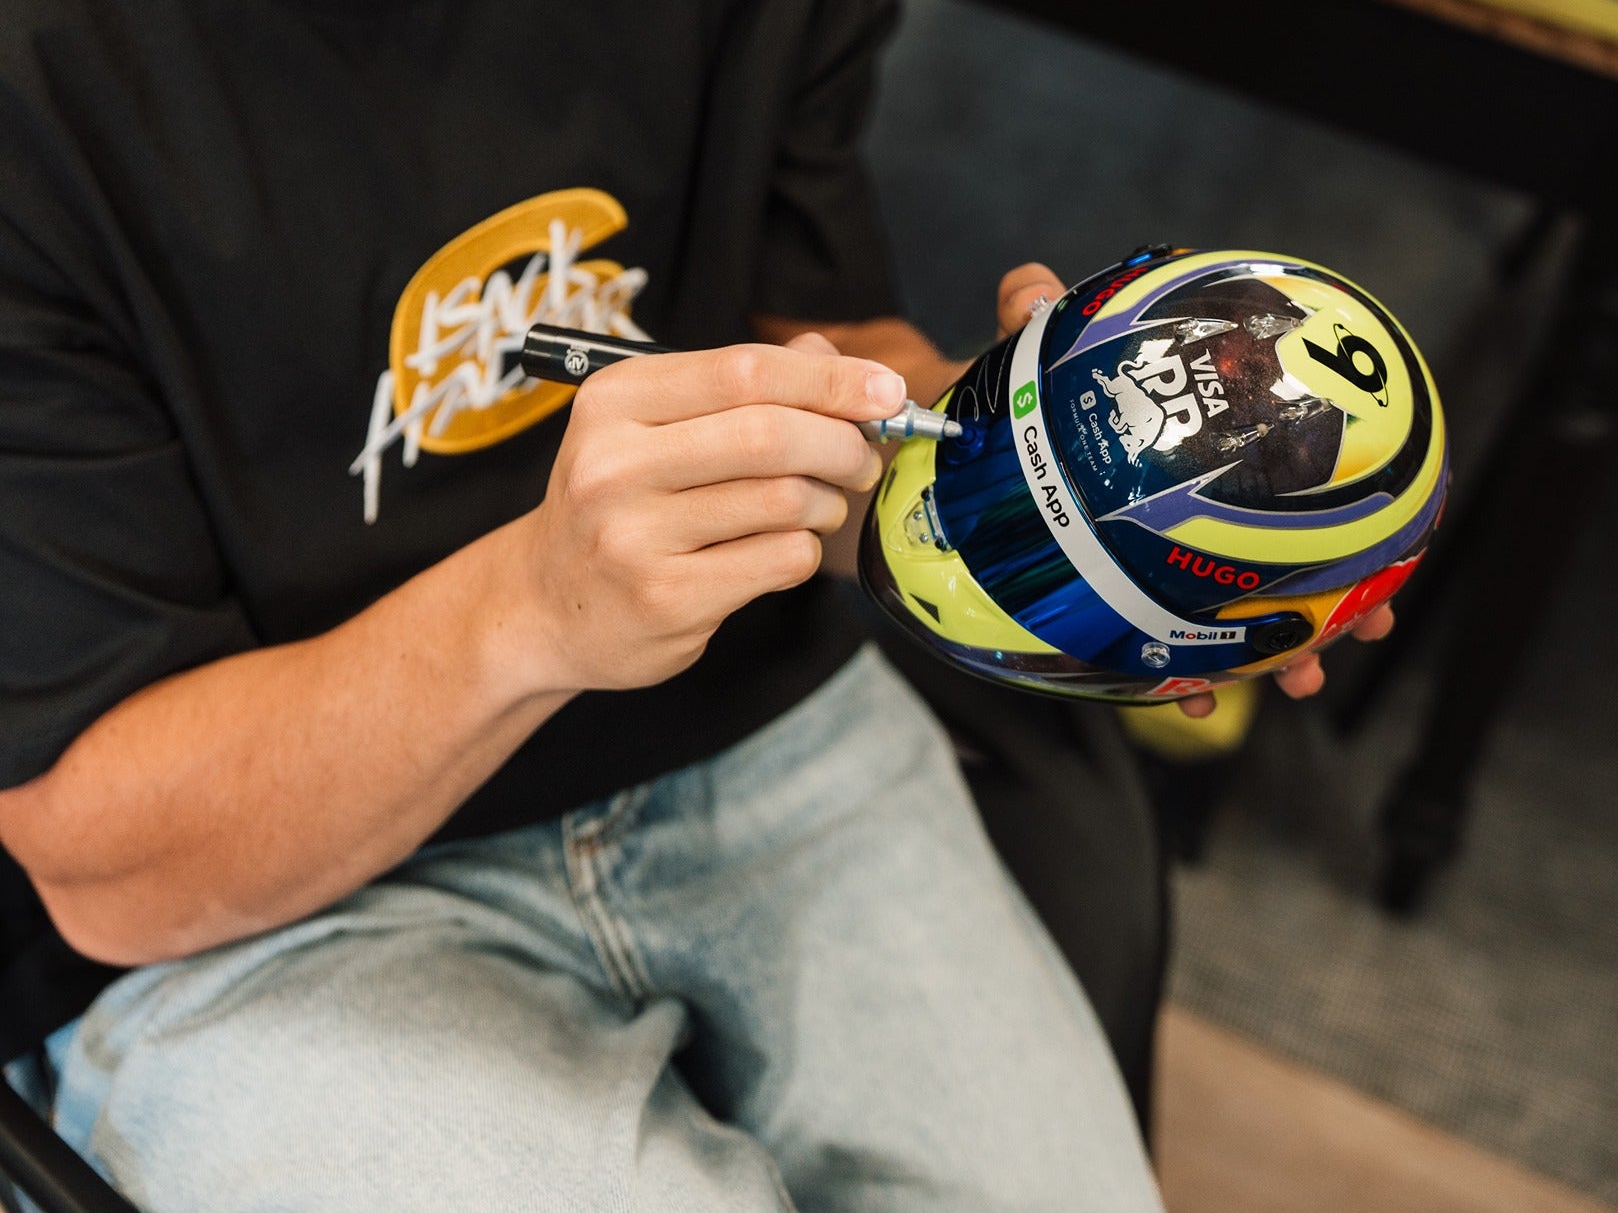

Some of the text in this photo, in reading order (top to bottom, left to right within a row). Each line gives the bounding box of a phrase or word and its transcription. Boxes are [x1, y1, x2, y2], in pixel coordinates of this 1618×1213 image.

[1190, 348, 1230, 418] VISA
[1079, 434, 1089, 450] ONE
[1086, 450, 1099, 472] TEAM
[1088, 412, 1113, 465] Cash App
[1024, 425, 1070, 528] Cash App
[1166, 546, 1261, 590] HUGO
[1169, 630, 1218, 641] Mobil
